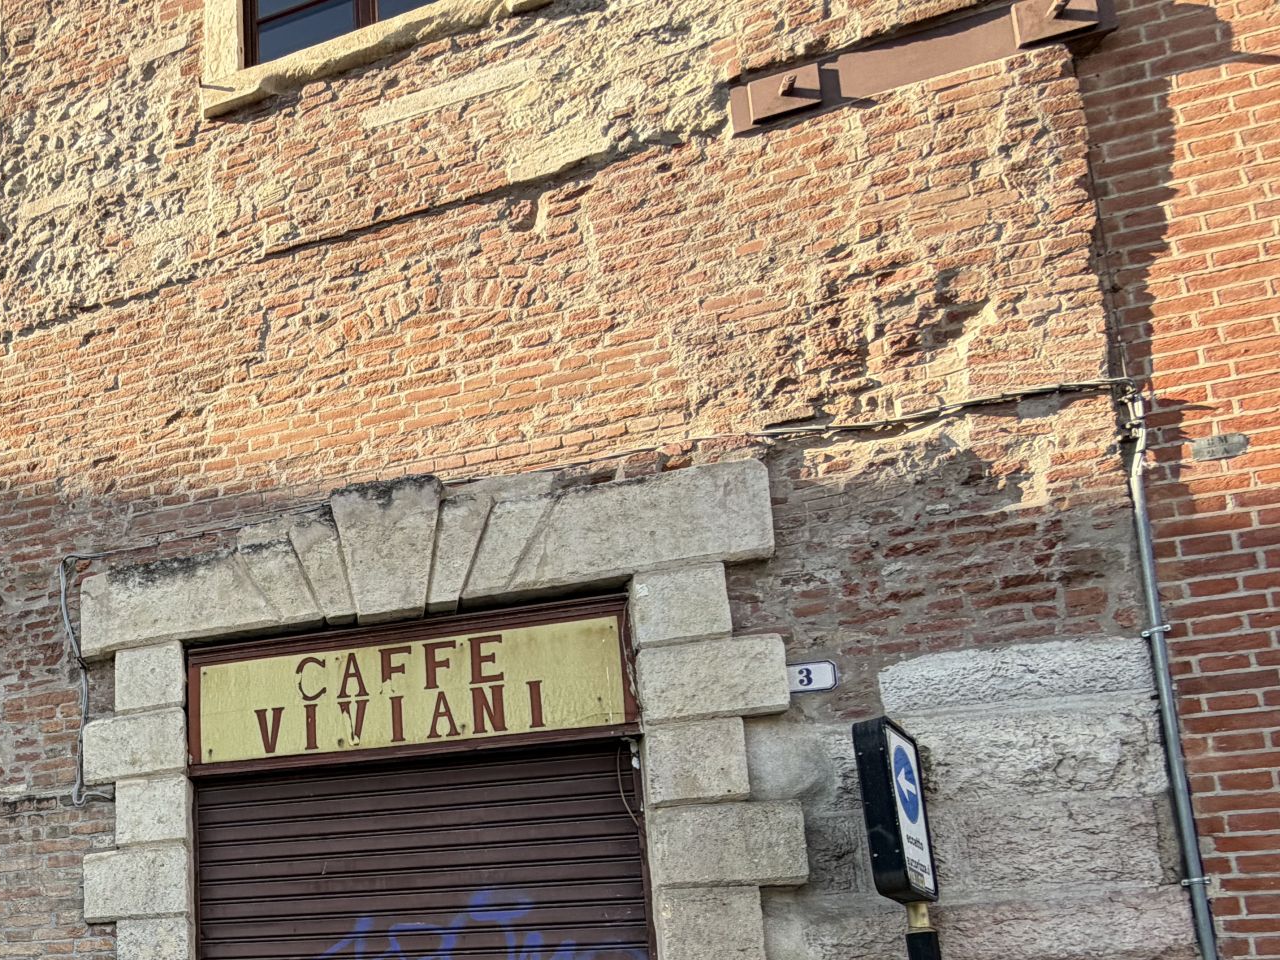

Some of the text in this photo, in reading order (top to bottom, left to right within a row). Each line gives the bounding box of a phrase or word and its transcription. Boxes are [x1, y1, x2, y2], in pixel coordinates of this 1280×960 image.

[296, 634, 504, 701] CAFFE
[798, 667, 813, 687] 3
[255, 679, 546, 754] VIVIANI
